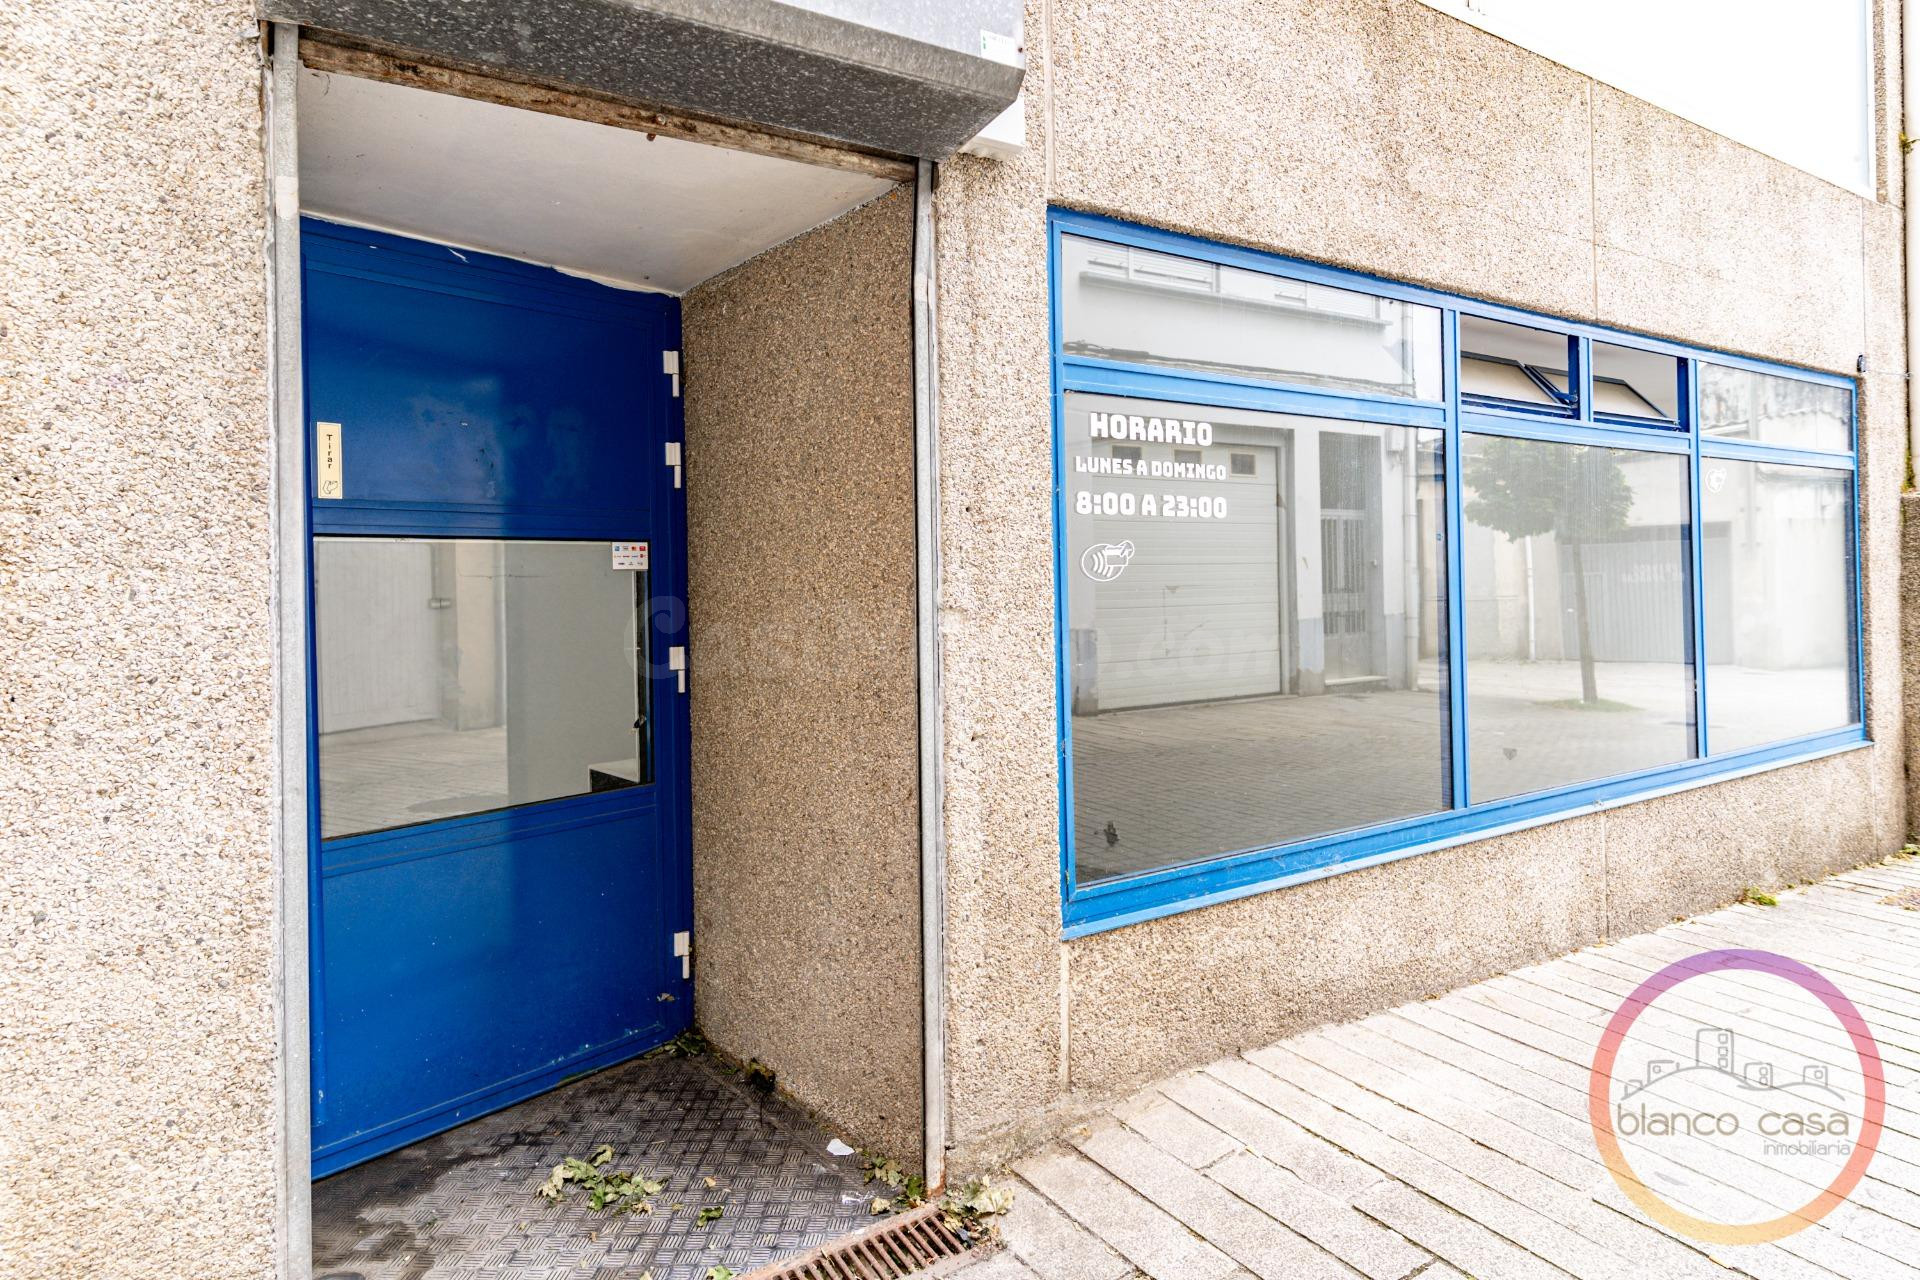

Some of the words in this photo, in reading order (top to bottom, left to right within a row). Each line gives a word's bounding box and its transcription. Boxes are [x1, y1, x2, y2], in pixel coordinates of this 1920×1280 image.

[1090, 412, 1213, 446] HORARIO
[1075, 456, 1133, 475] LUNES
[1137, 461, 1148, 476] A
[1151, 461, 1227, 480] DOMINGO
[1076, 491, 1136, 515] 8:00
[1141, 494, 1157, 516] A
[1162, 494, 1228, 518] 23:00
